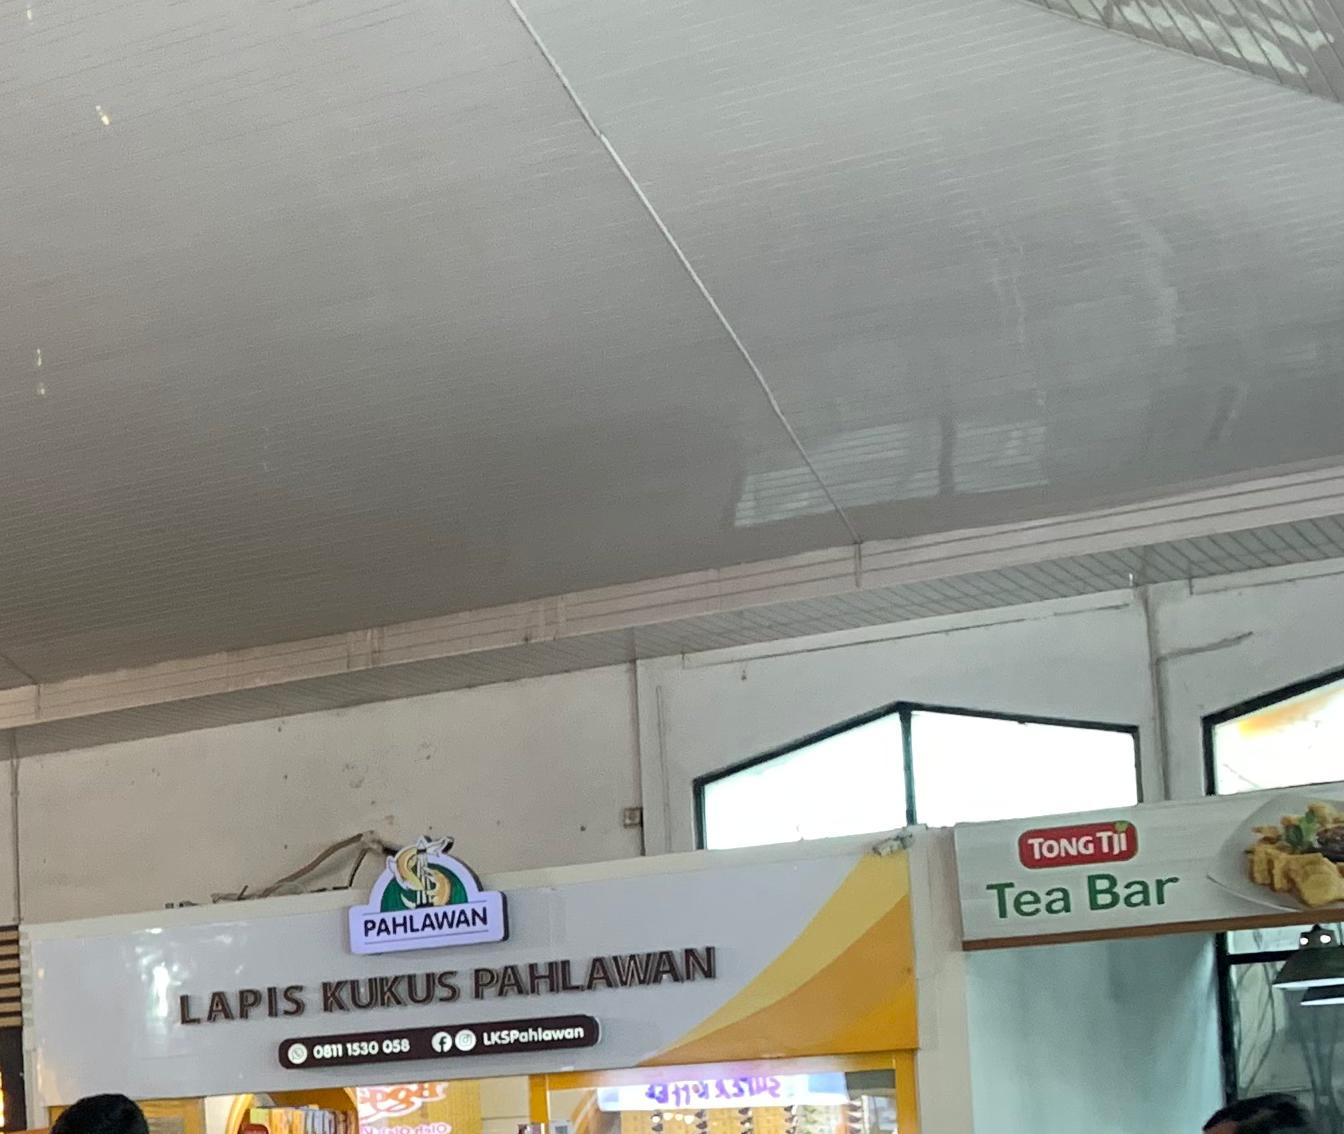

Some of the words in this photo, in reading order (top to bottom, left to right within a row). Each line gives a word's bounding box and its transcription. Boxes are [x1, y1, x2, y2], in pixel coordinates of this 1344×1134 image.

[1028, 836, 1094, 860] TONG
[986, 882, 1072, 919] Tea
[1087, 873, 1180, 911] Bar
[364, 906, 489, 938] PAHLAWAN
[179, 985, 307, 1025] LAPIS
[322, 970, 461, 1014] KUKUS
[473, 946, 716, 1001] PAHLAWAN
[313, 1043, 343, 1059] 0811
[345, 1040, 380, 1056] 1530
[383, 1038, 411, 1054] 058
[482, 1026, 585, 1047] LKSPahlawan
